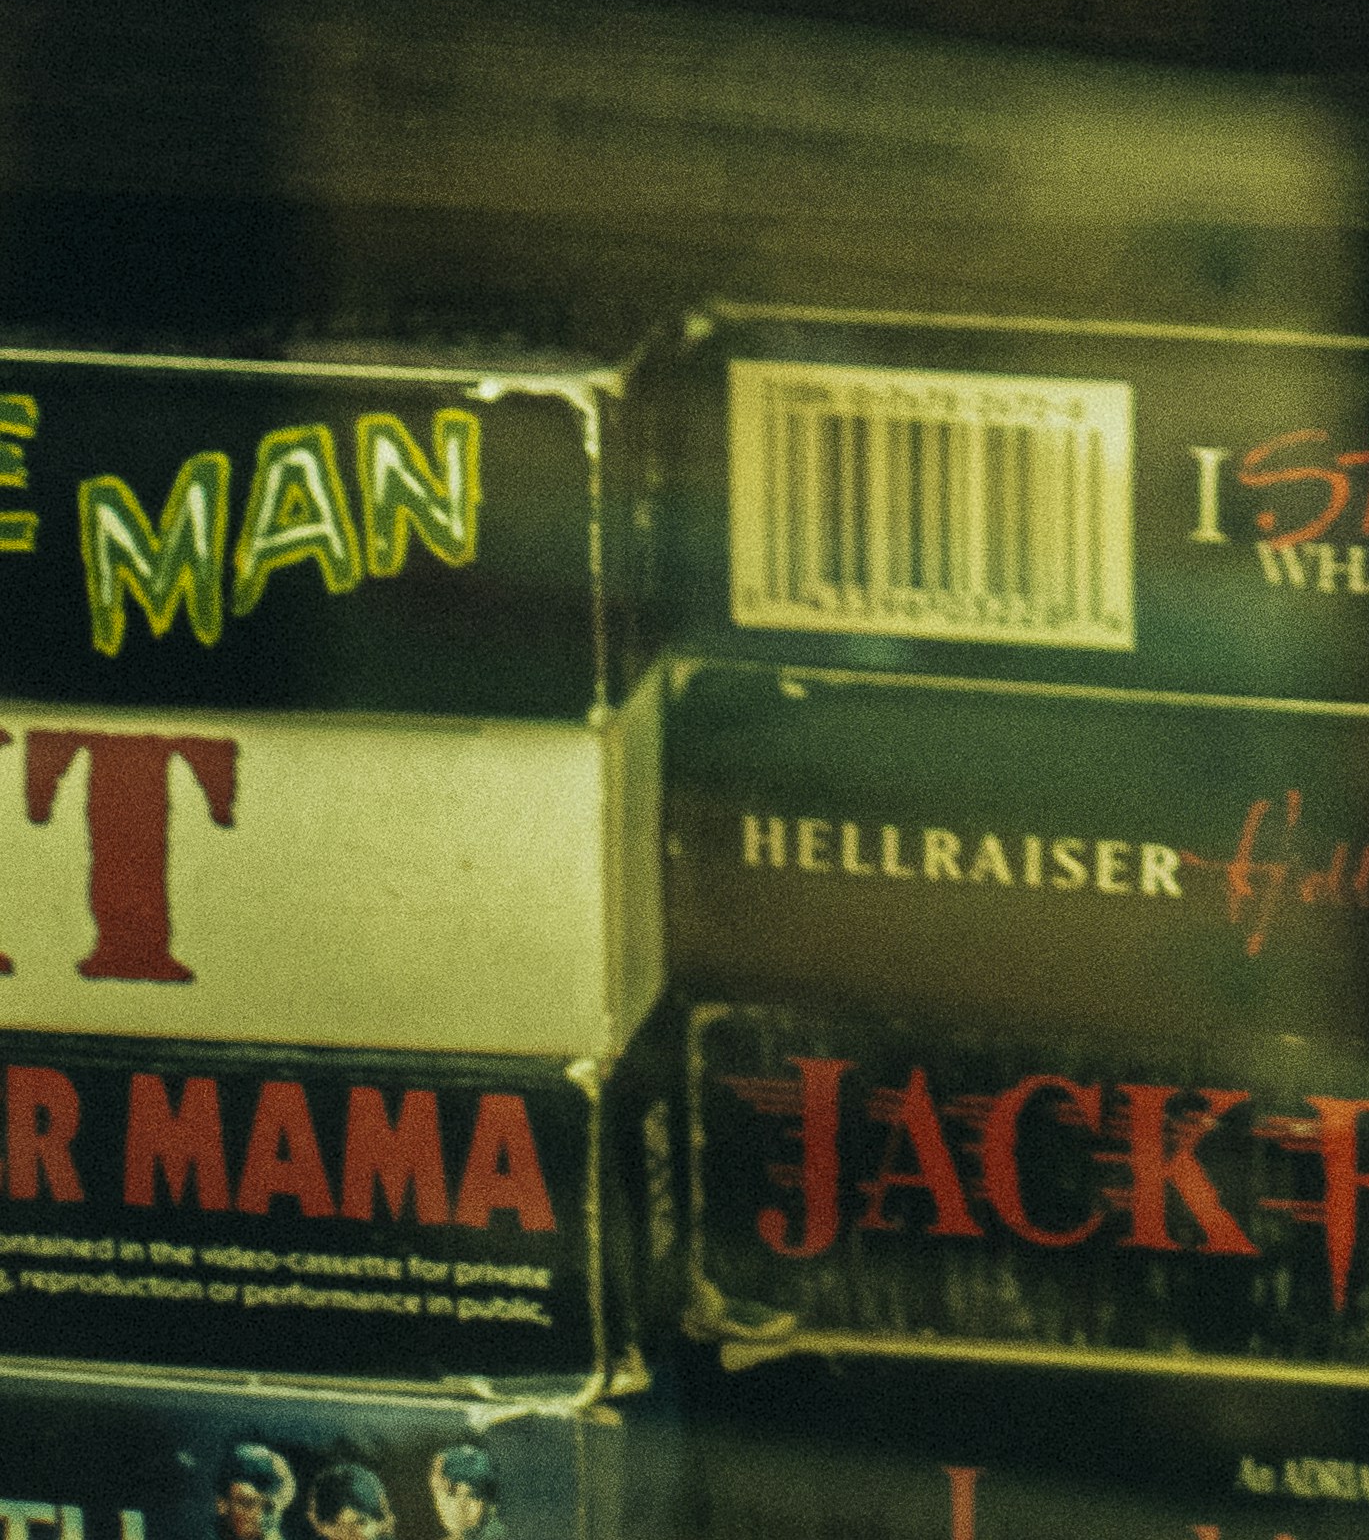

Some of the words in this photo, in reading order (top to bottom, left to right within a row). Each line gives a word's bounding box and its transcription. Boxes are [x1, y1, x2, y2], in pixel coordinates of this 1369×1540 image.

[79, 408, 482, 657] MAN
[1189, 446, 1226, 543] I
[741, 814, 1184, 899] HELLRAISER
[123, 1071, 558, 1234] MAMA
[735, 1056, 1262, 1260] JACK
[19, 1268, 201, 1302] reproduction
[207, 1281, 238, 1302] or
[242, 1282, 422, 1316] performance
[427, 1294, 454, 1316] in
[119, 1242, 146, 1262] in
[149, 1241, 195, 1265] the
[408, 1254, 450, 1281] for
[454, 1261, 551, 1290] private
